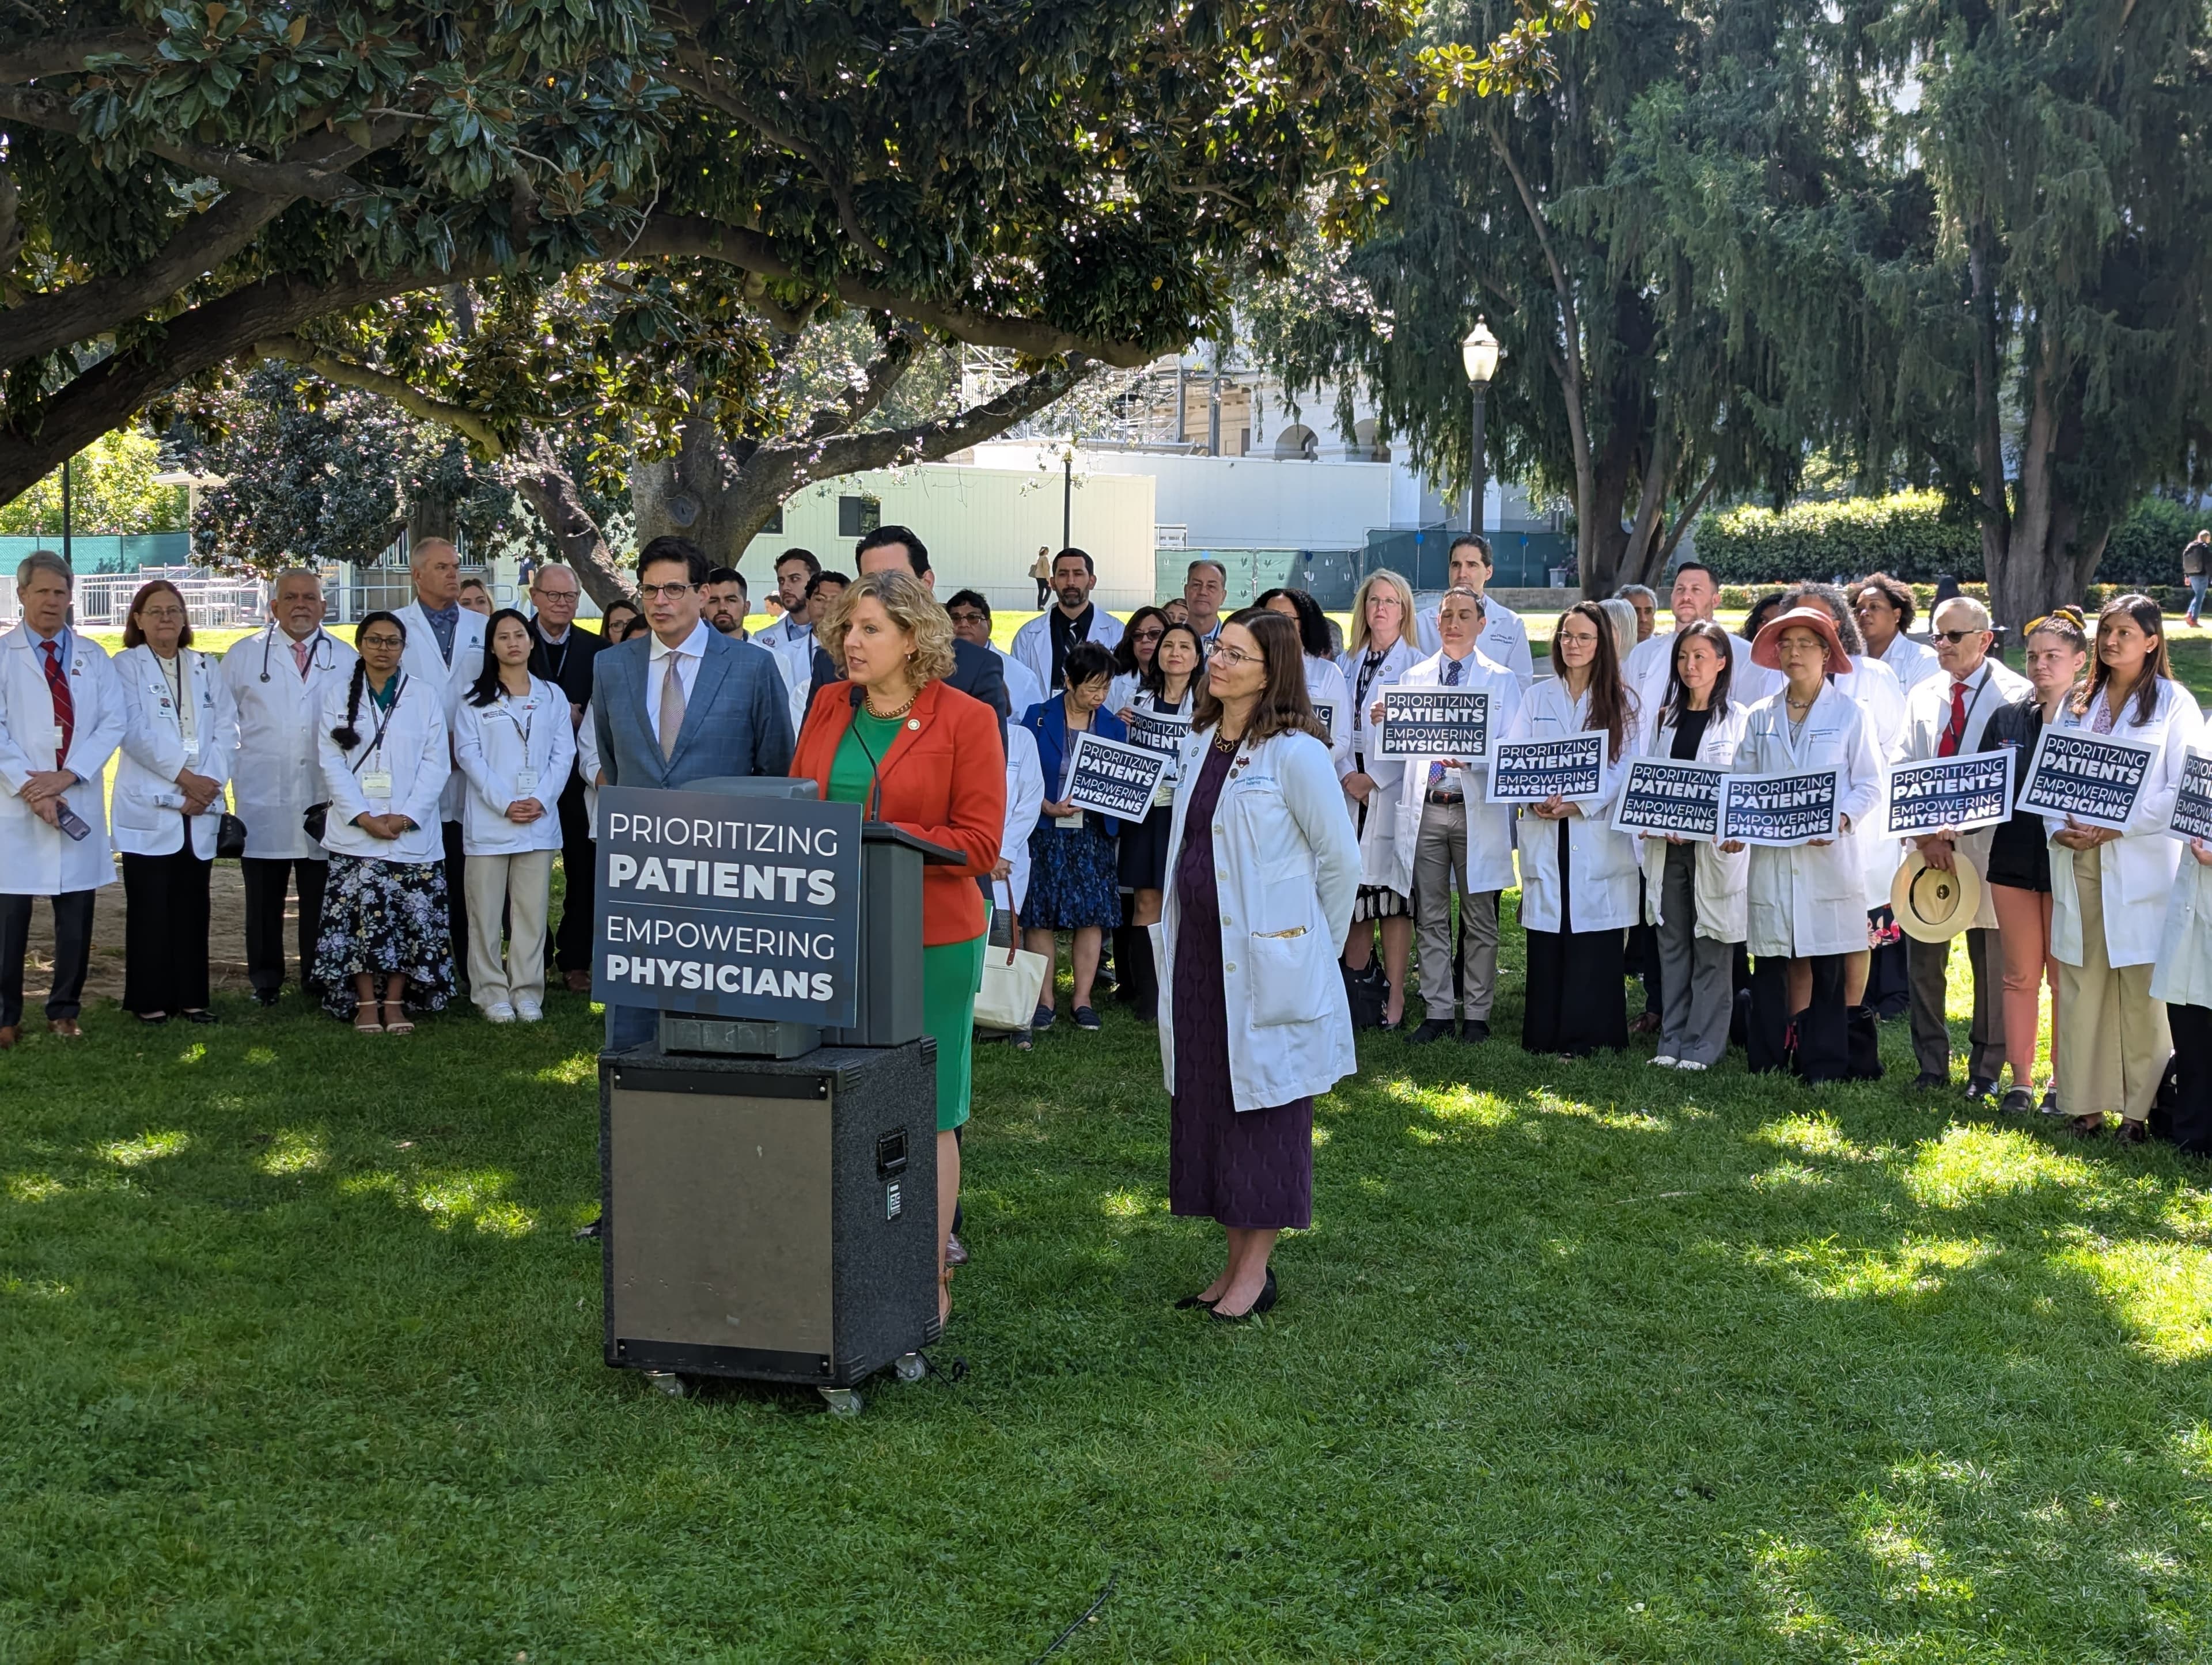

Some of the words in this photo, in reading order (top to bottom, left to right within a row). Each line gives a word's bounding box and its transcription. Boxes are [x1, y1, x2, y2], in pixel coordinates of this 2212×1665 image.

[1387, 695, 1485, 708] PRIORITIZING
[1131, 716, 1192, 736] PRIORITIZIN
[1387, 708, 1484, 723] PATIENTS
[1131, 727, 1184, 750] PATIENT
[1385, 728, 1483, 741] EMPOWERING
[1385, 739, 1483, 753] PHYSICIANS
[1082, 744, 1160, 772] PRIORITIZING
[1499, 751, 1597, 770] PATIENTS
[1500, 740, 1598, 757] PRIORITIZING
[2046, 738, 2146, 768] PRIORITIZING
[1078, 756, 1155, 786] PATIENTS
[1498, 770, 1597, 785] EMPOWERING
[1894, 760, 2004, 786] PRIORITIZING
[2041, 752, 2142, 785] PATIENTS
[1074, 775, 1147, 802] EMPOWERING
[1497, 780, 1596, 795] PHYSICIANS
[1630, 777, 1719, 801] PATIENTS
[1730, 775, 1833, 795] PRIORITIZING
[1893, 772, 2003, 800] PATIENTS
[2035, 775, 2133, 805] EMPOWERING
[1072, 786, 1143, 813] PHYSICIANS
[1625, 799, 1717, 819] EMPOWERING
[1729, 787, 1832, 809] PATIENTS
[1892, 792, 2002, 818] EMPOWERING
[2029, 790, 2127, 820] PHYSICIANS
[1622, 810, 1715, 832] PHYSICIANS
[1728, 807, 1830, 825] EMPOWERING
[1891, 803, 2001, 830] PHYSICIANS
[609, 813, 838, 856] PRIORITIZING
[1726, 820, 1829, 837] PHYSICIANS
[609, 854, 836, 905] PATIENTS
[607, 916, 834, 960] EMPOWERING
[607, 954, 834, 1002] PHYSICIANS
